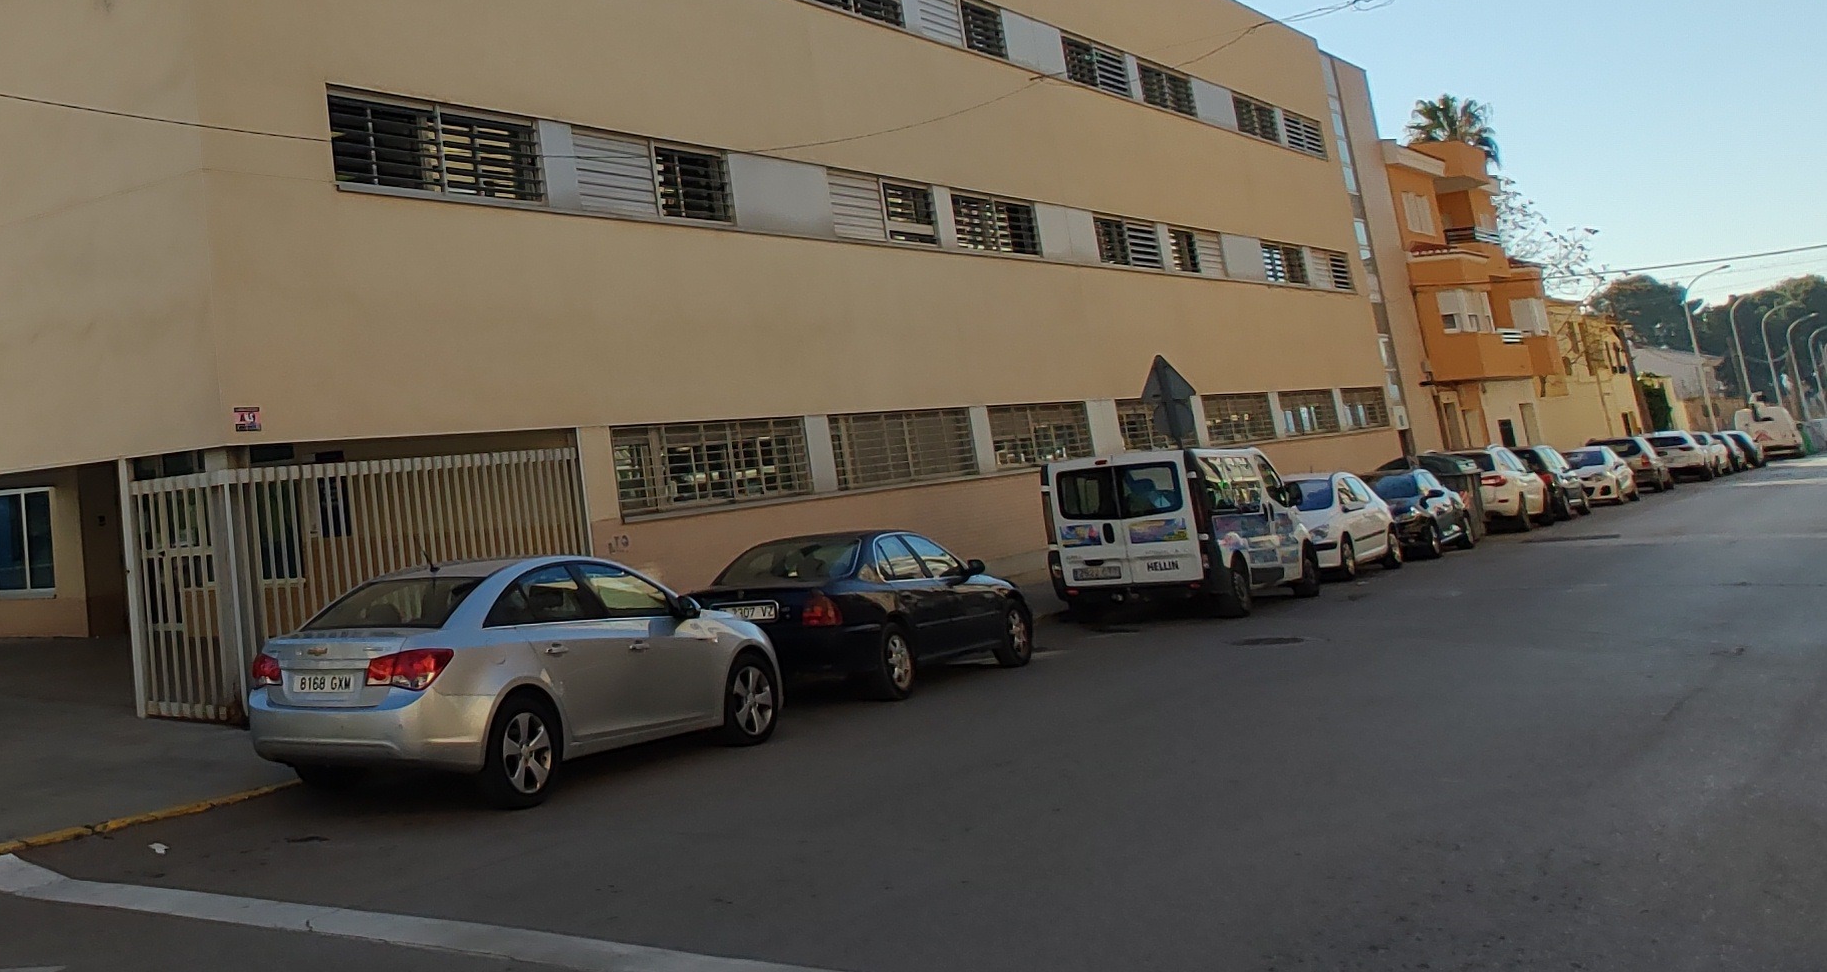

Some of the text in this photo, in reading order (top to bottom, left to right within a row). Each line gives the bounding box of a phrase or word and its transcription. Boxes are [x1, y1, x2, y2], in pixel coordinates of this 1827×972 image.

[1146, 560, 1180, 572] HELLIN
[299, 676, 352, 691] 8168 GXM
